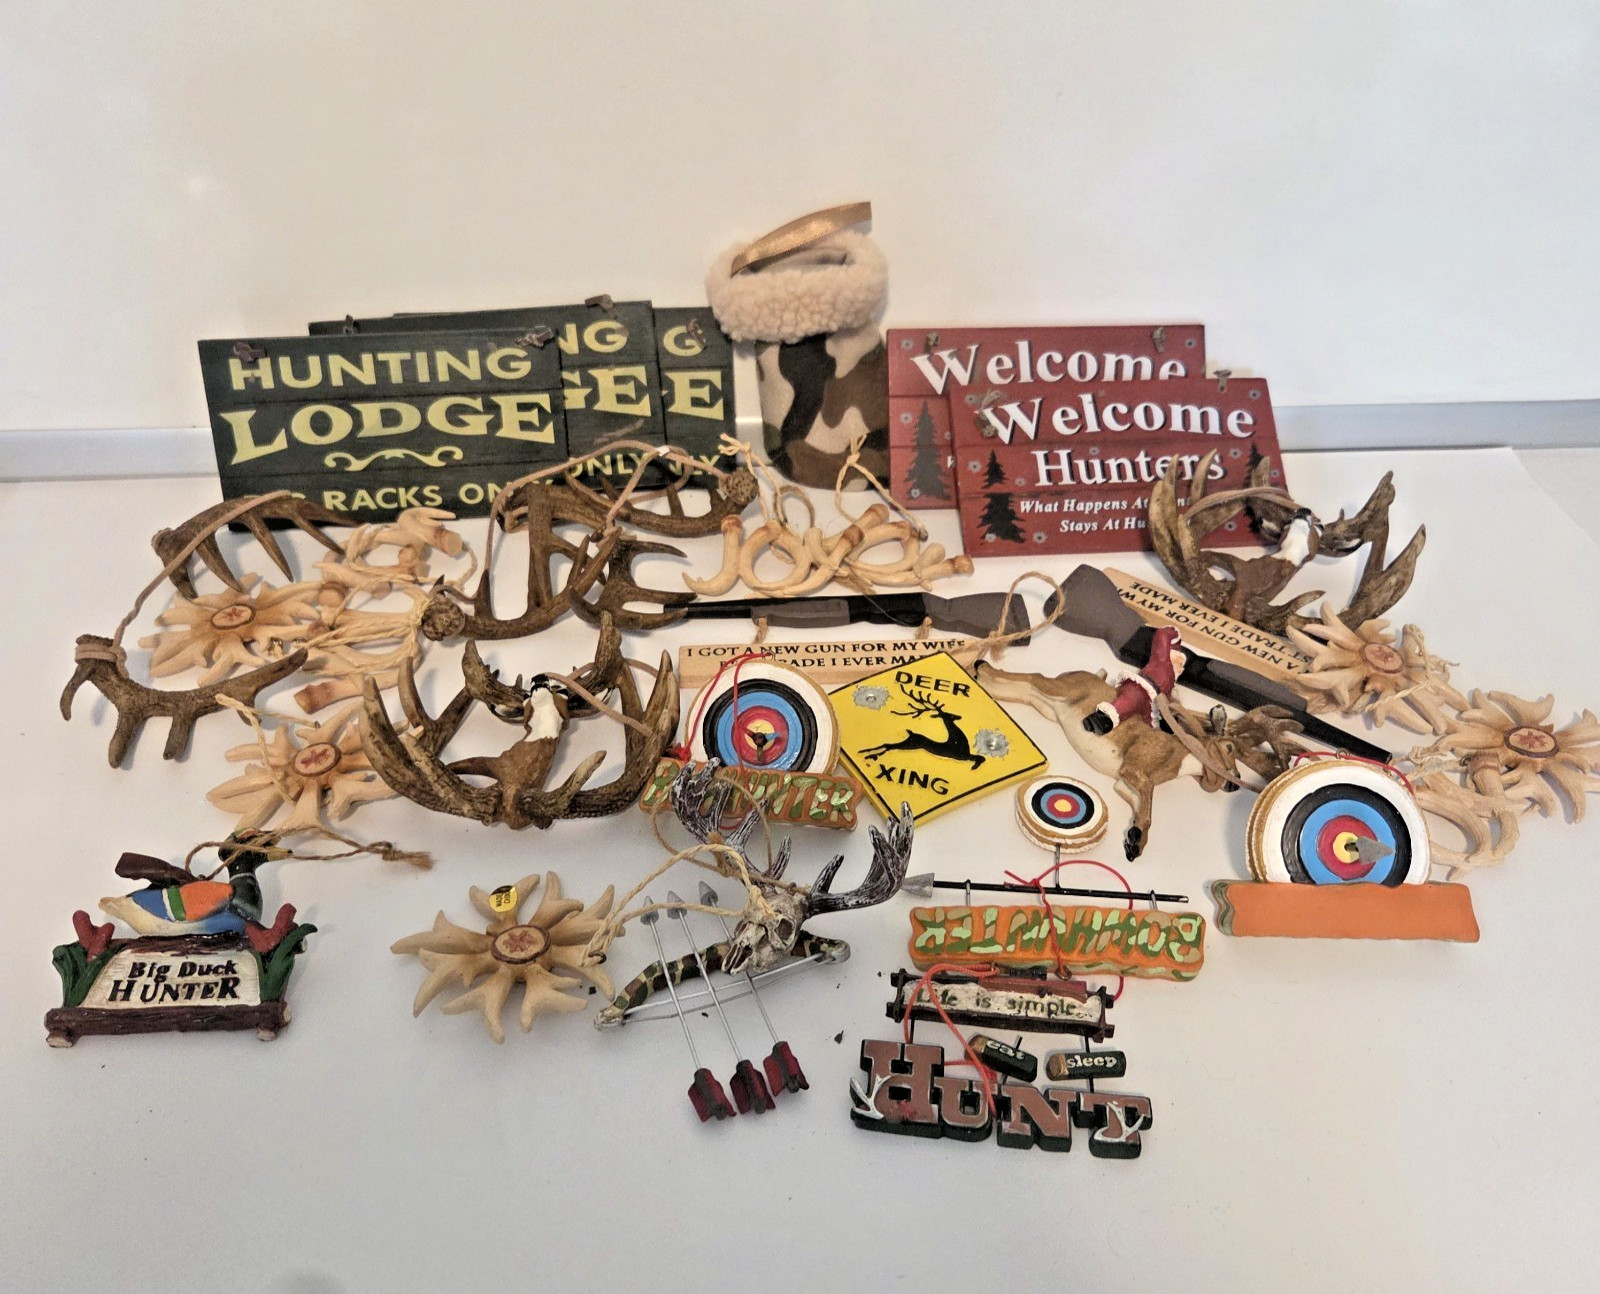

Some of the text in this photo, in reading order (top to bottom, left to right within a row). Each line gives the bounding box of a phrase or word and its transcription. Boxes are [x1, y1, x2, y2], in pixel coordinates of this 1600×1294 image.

[228, 347, 532, 391] HUNTING
[219, 392, 556, 466] LODGE
[975, 393, 1257, 446] Welcome
[1030, 449, 1225, 487] Hunters
[323, 484, 443, 512] RACKS
[1019, 496, 1148, 517] What Happens At
[1059, 518, 1098, 533] Stays
[1102, 517, 1120, 531] At
[1129, 581, 1178, 605] MADE
[1136, 598, 1164, 612] MY
[1164, 609, 1202, 629] FOR
[1179, 601, 1219, 623] EVER
[1200, 626, 1241, 646] GUN
[1230, 624, 1286, 654] TRADE
[687, 648, 693, 657] I
[698, 646, 740, 657] GOT
[743, 646, 754, 655] A
[804, 643, 846, 654] GUN
[852, 642, 888, 652] FOR
[892, 641, 919, 651] MY
[830, 658, 837, 666] I
[843, 655, 888, 667] EVER
[1242, 644, 1283, 665] NEW
[895, 670, 971, 698] DEER
[875, 763, 951, 796] XING
[128, 959, 239, 983] Big Duck
[107, 976, 241, 1004] HUNTER
[986, 1039, 1026, 1061] eat
[1066, 1054, 1118, 1069] sleep
[851, 1039, 1152, 1158] HUNT
